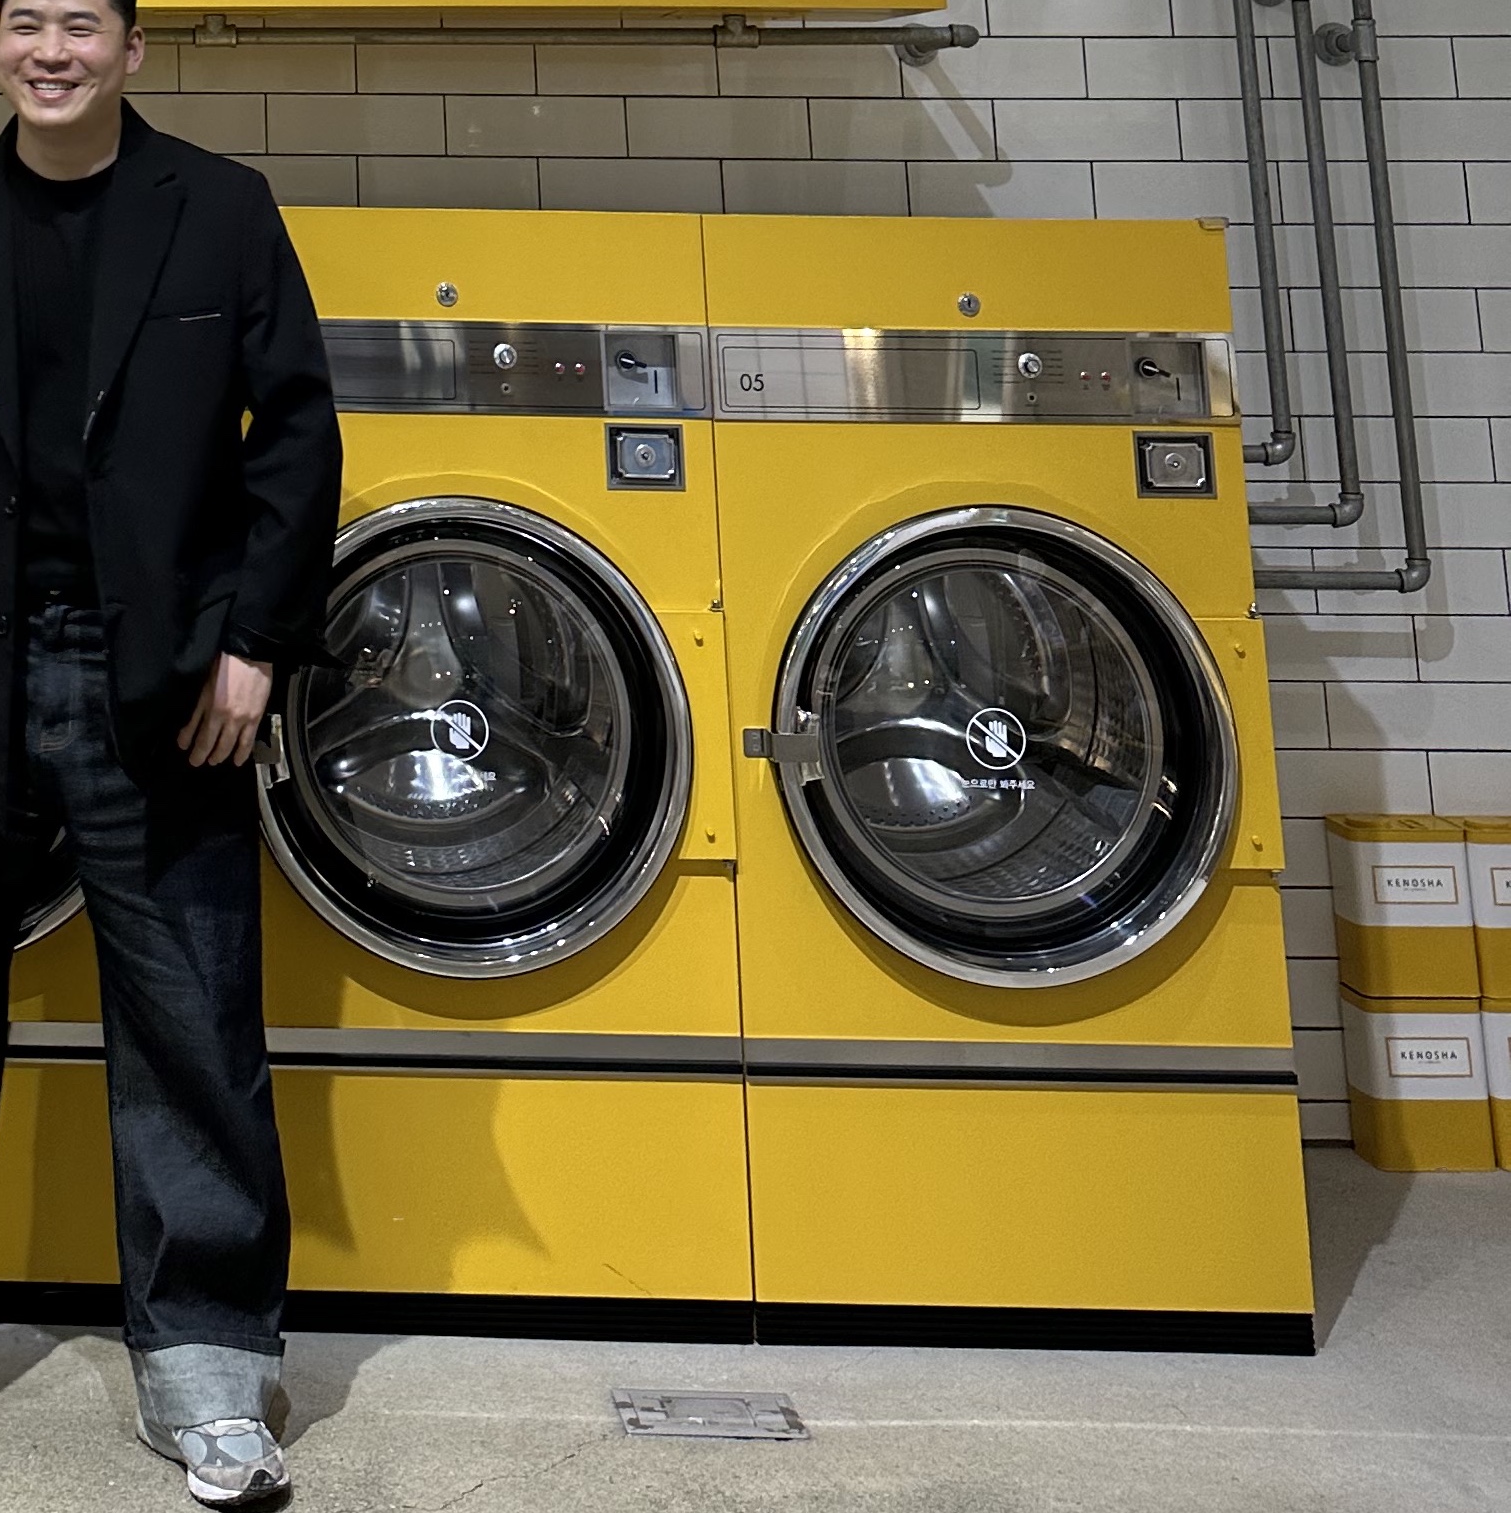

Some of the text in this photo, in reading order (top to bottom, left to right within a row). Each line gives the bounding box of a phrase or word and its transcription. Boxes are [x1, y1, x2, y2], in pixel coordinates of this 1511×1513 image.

[739, 373, 765, 392] 05
[1387, 879, 1444, 888] KENOSHA
[1400, 1051, 1458, 1060] KENOSHA
